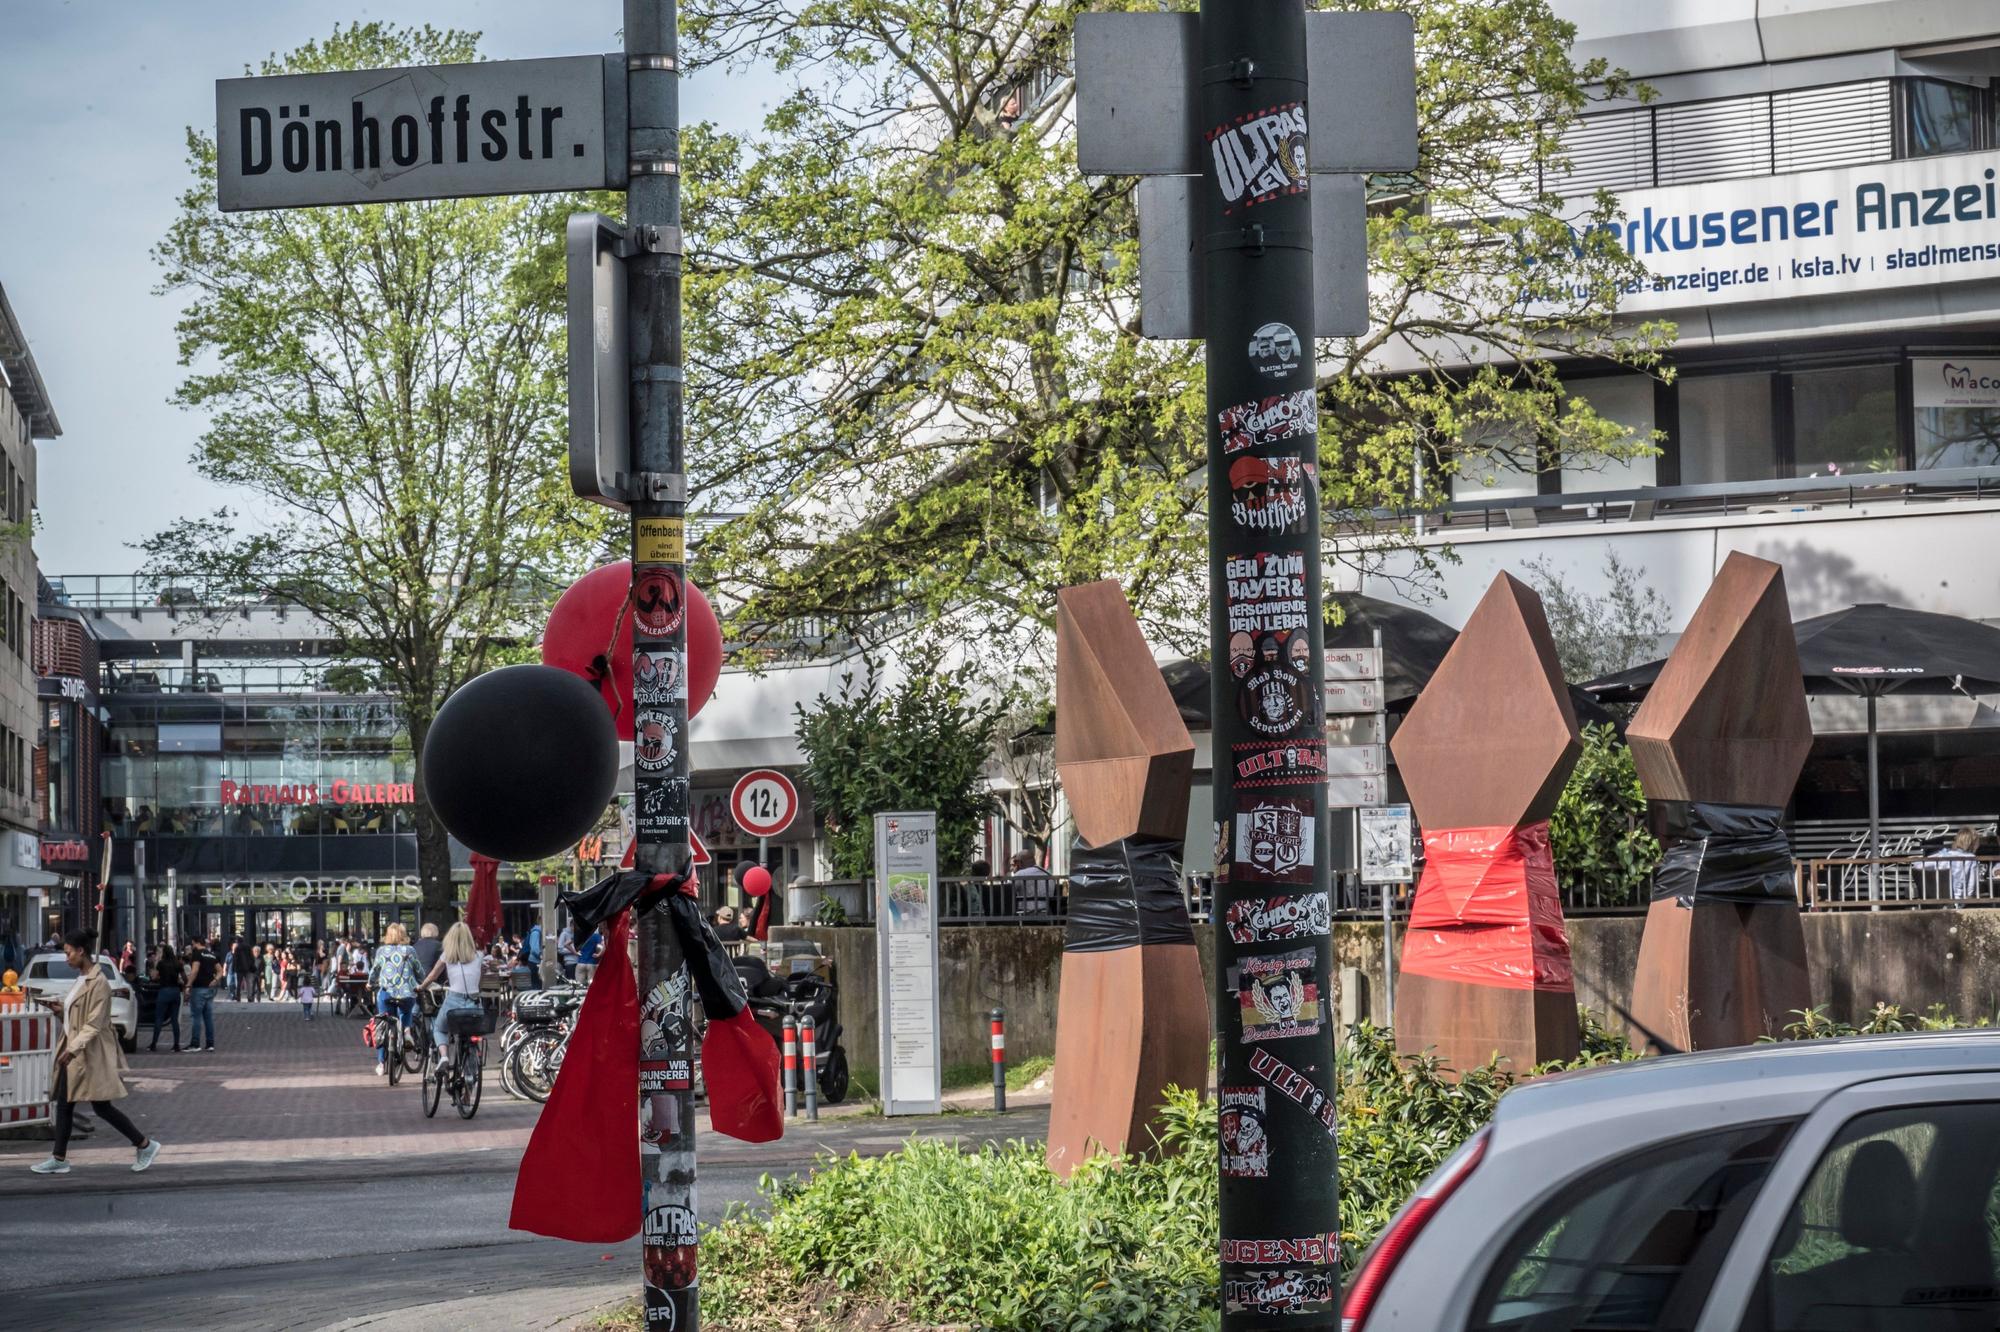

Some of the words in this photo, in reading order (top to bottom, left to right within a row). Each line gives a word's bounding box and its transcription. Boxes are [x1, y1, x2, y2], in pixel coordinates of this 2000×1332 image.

[239, 94, 586, 176] Dönhoffstr.
[1212, 107, 1308, 202] ULTRAS
[1249, 159, 1291, 198] LEV
[1516, 199, 1838, 267] verkusener
[1792, 254, 1861, 279] ksta.tv
[1886, 243, 2000, 270] stadtmens
[1247, 394, 1299, 432] CHAOS
[1232, 496, 1306, 536] Brothers
[650, 550, 679, 559] überall
[1226, 559, 1258, 579] GEH
[1264, 554, 1304, 577] ZUM
[1228, 577, 1290, 600] BAYER
[1228, 600, 1307, 617] VERSCHWENDE
[1229, 616, 1261, 633] DEIN
[1264, 614, 1308, 631] LEBEN
[1356, 653, 1364, 662] 13
[1247, 671, 1270, 690] Mad
[1249, 709, 1304, 734] Leverkusen
[1250, 831, 1301, 846] KATEGORIE
[1254, 847, 1273, 856] OFC
[222, 875, 423, 901] KINOPOLIS
[1252, 896, 1308, 929] CHAOS
[1243, 957, 1285, 975] König
[1285, 957, 1311, 970] von
[1240, 1019, 1320, 1043] Deutschland
[668, 1060, 689, 1070] WIR.
[644, 1206, 697, 1236] ULTRAS
[644, 1235, 664, 1246] LEVER
[1257, 1277, 1304, 1303] CHAOS
